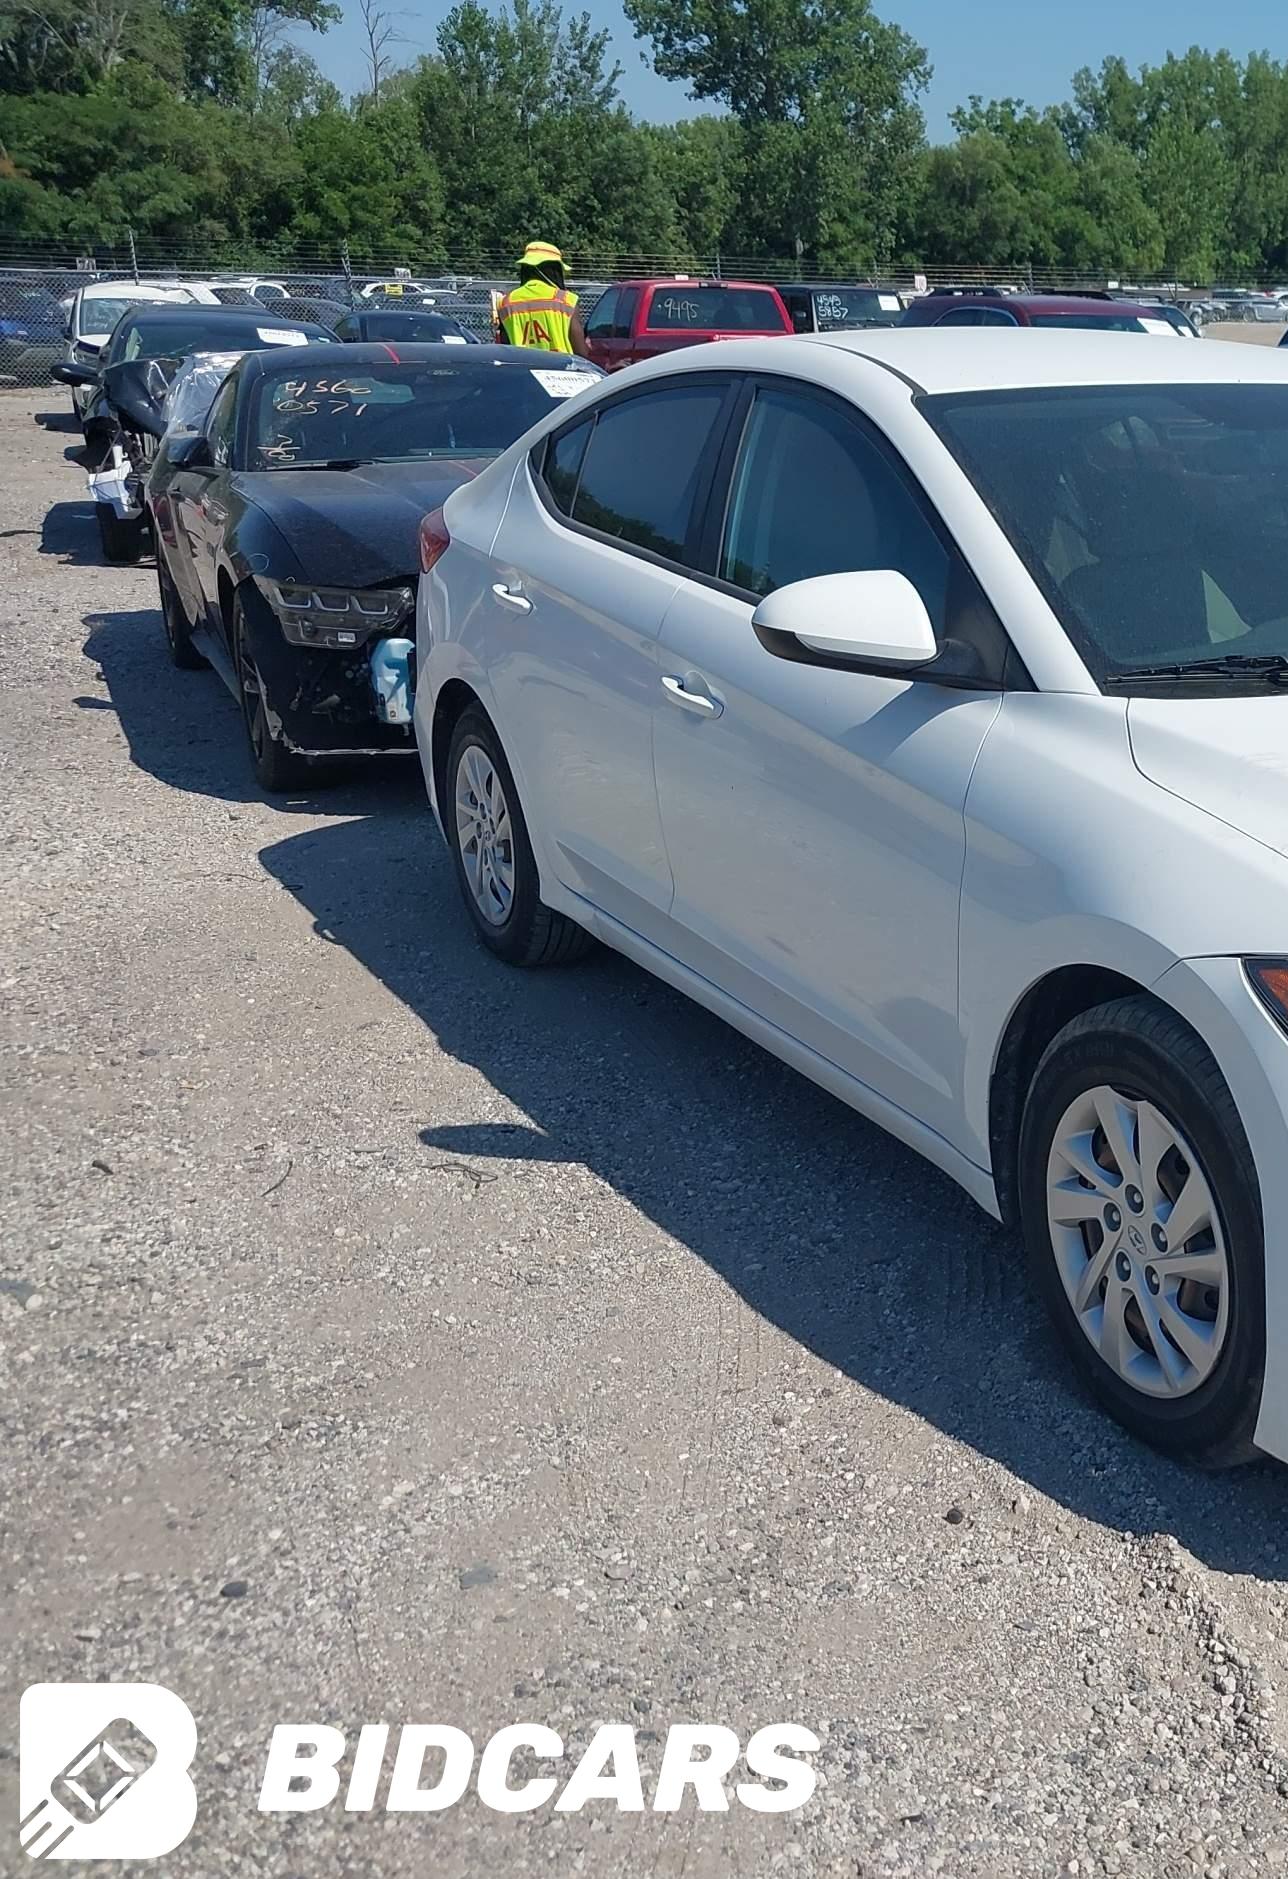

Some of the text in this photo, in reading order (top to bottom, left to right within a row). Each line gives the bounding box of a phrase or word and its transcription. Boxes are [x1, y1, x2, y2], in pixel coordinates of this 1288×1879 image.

[664, 298, 699, 321] 9495
[818, 305, 848, 318] 5857
[285, 379, 371, 397] 4560
[277, 399, 367, 417] 0571
